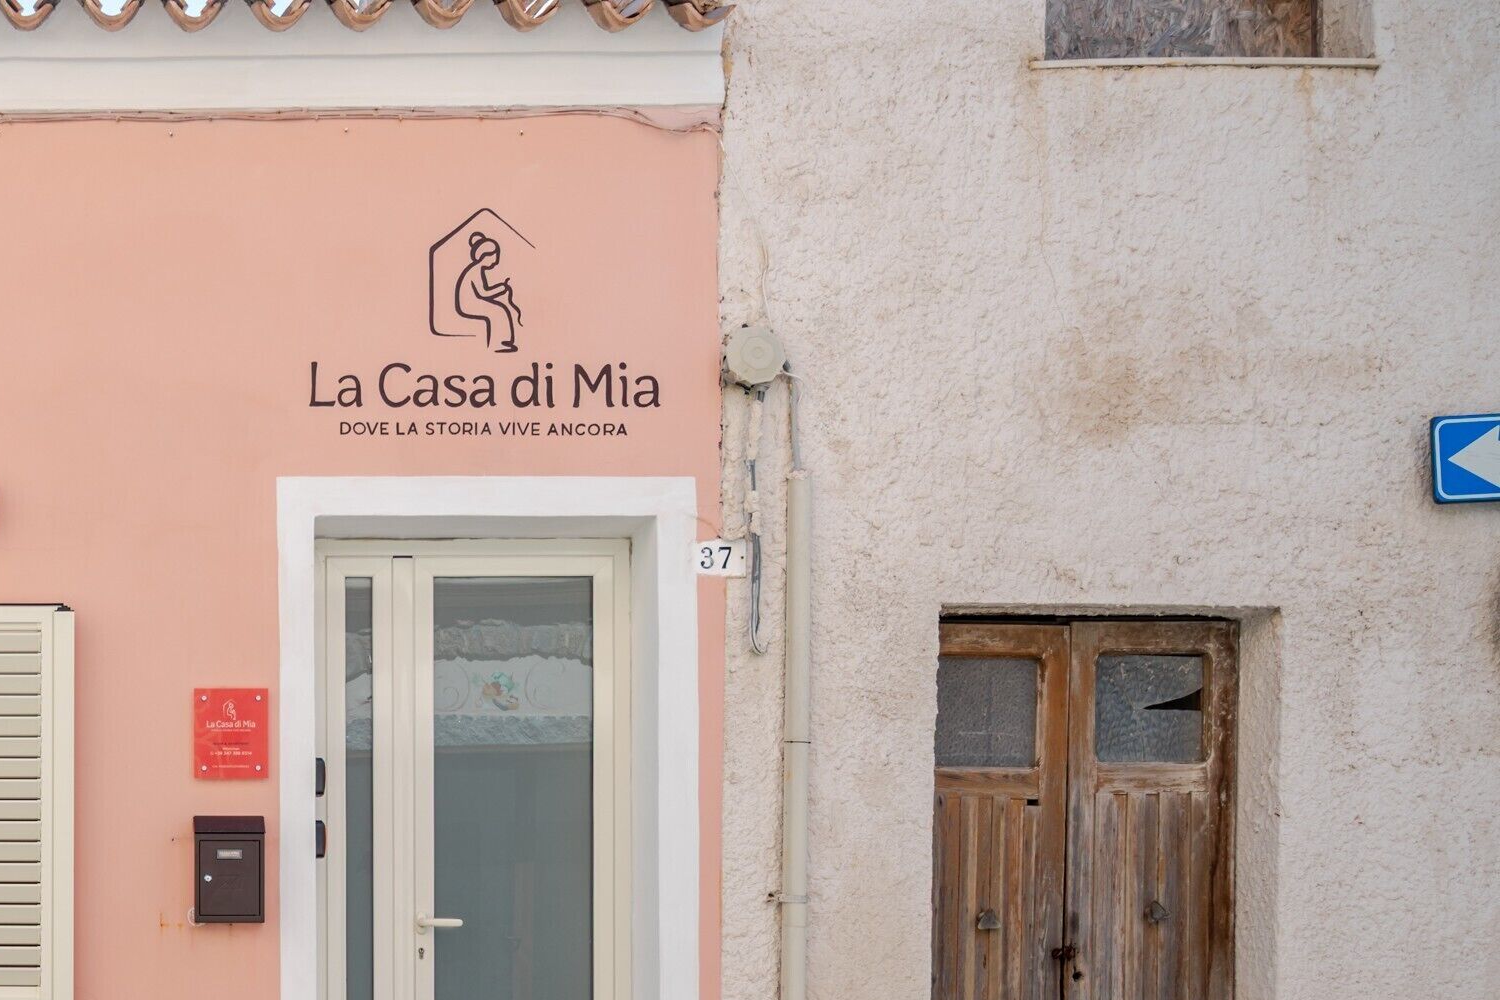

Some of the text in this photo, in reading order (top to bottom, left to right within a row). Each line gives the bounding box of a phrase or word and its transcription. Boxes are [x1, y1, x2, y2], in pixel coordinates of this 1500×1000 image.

[308, 361, 661, 409] La Casa di Mia
[339, 421, 628, 437] DOVE LA STORIA VIVE ANCORA
[700, 546, 732, 570] 37
[206, 720, 256, 728] La Casa di Mia
